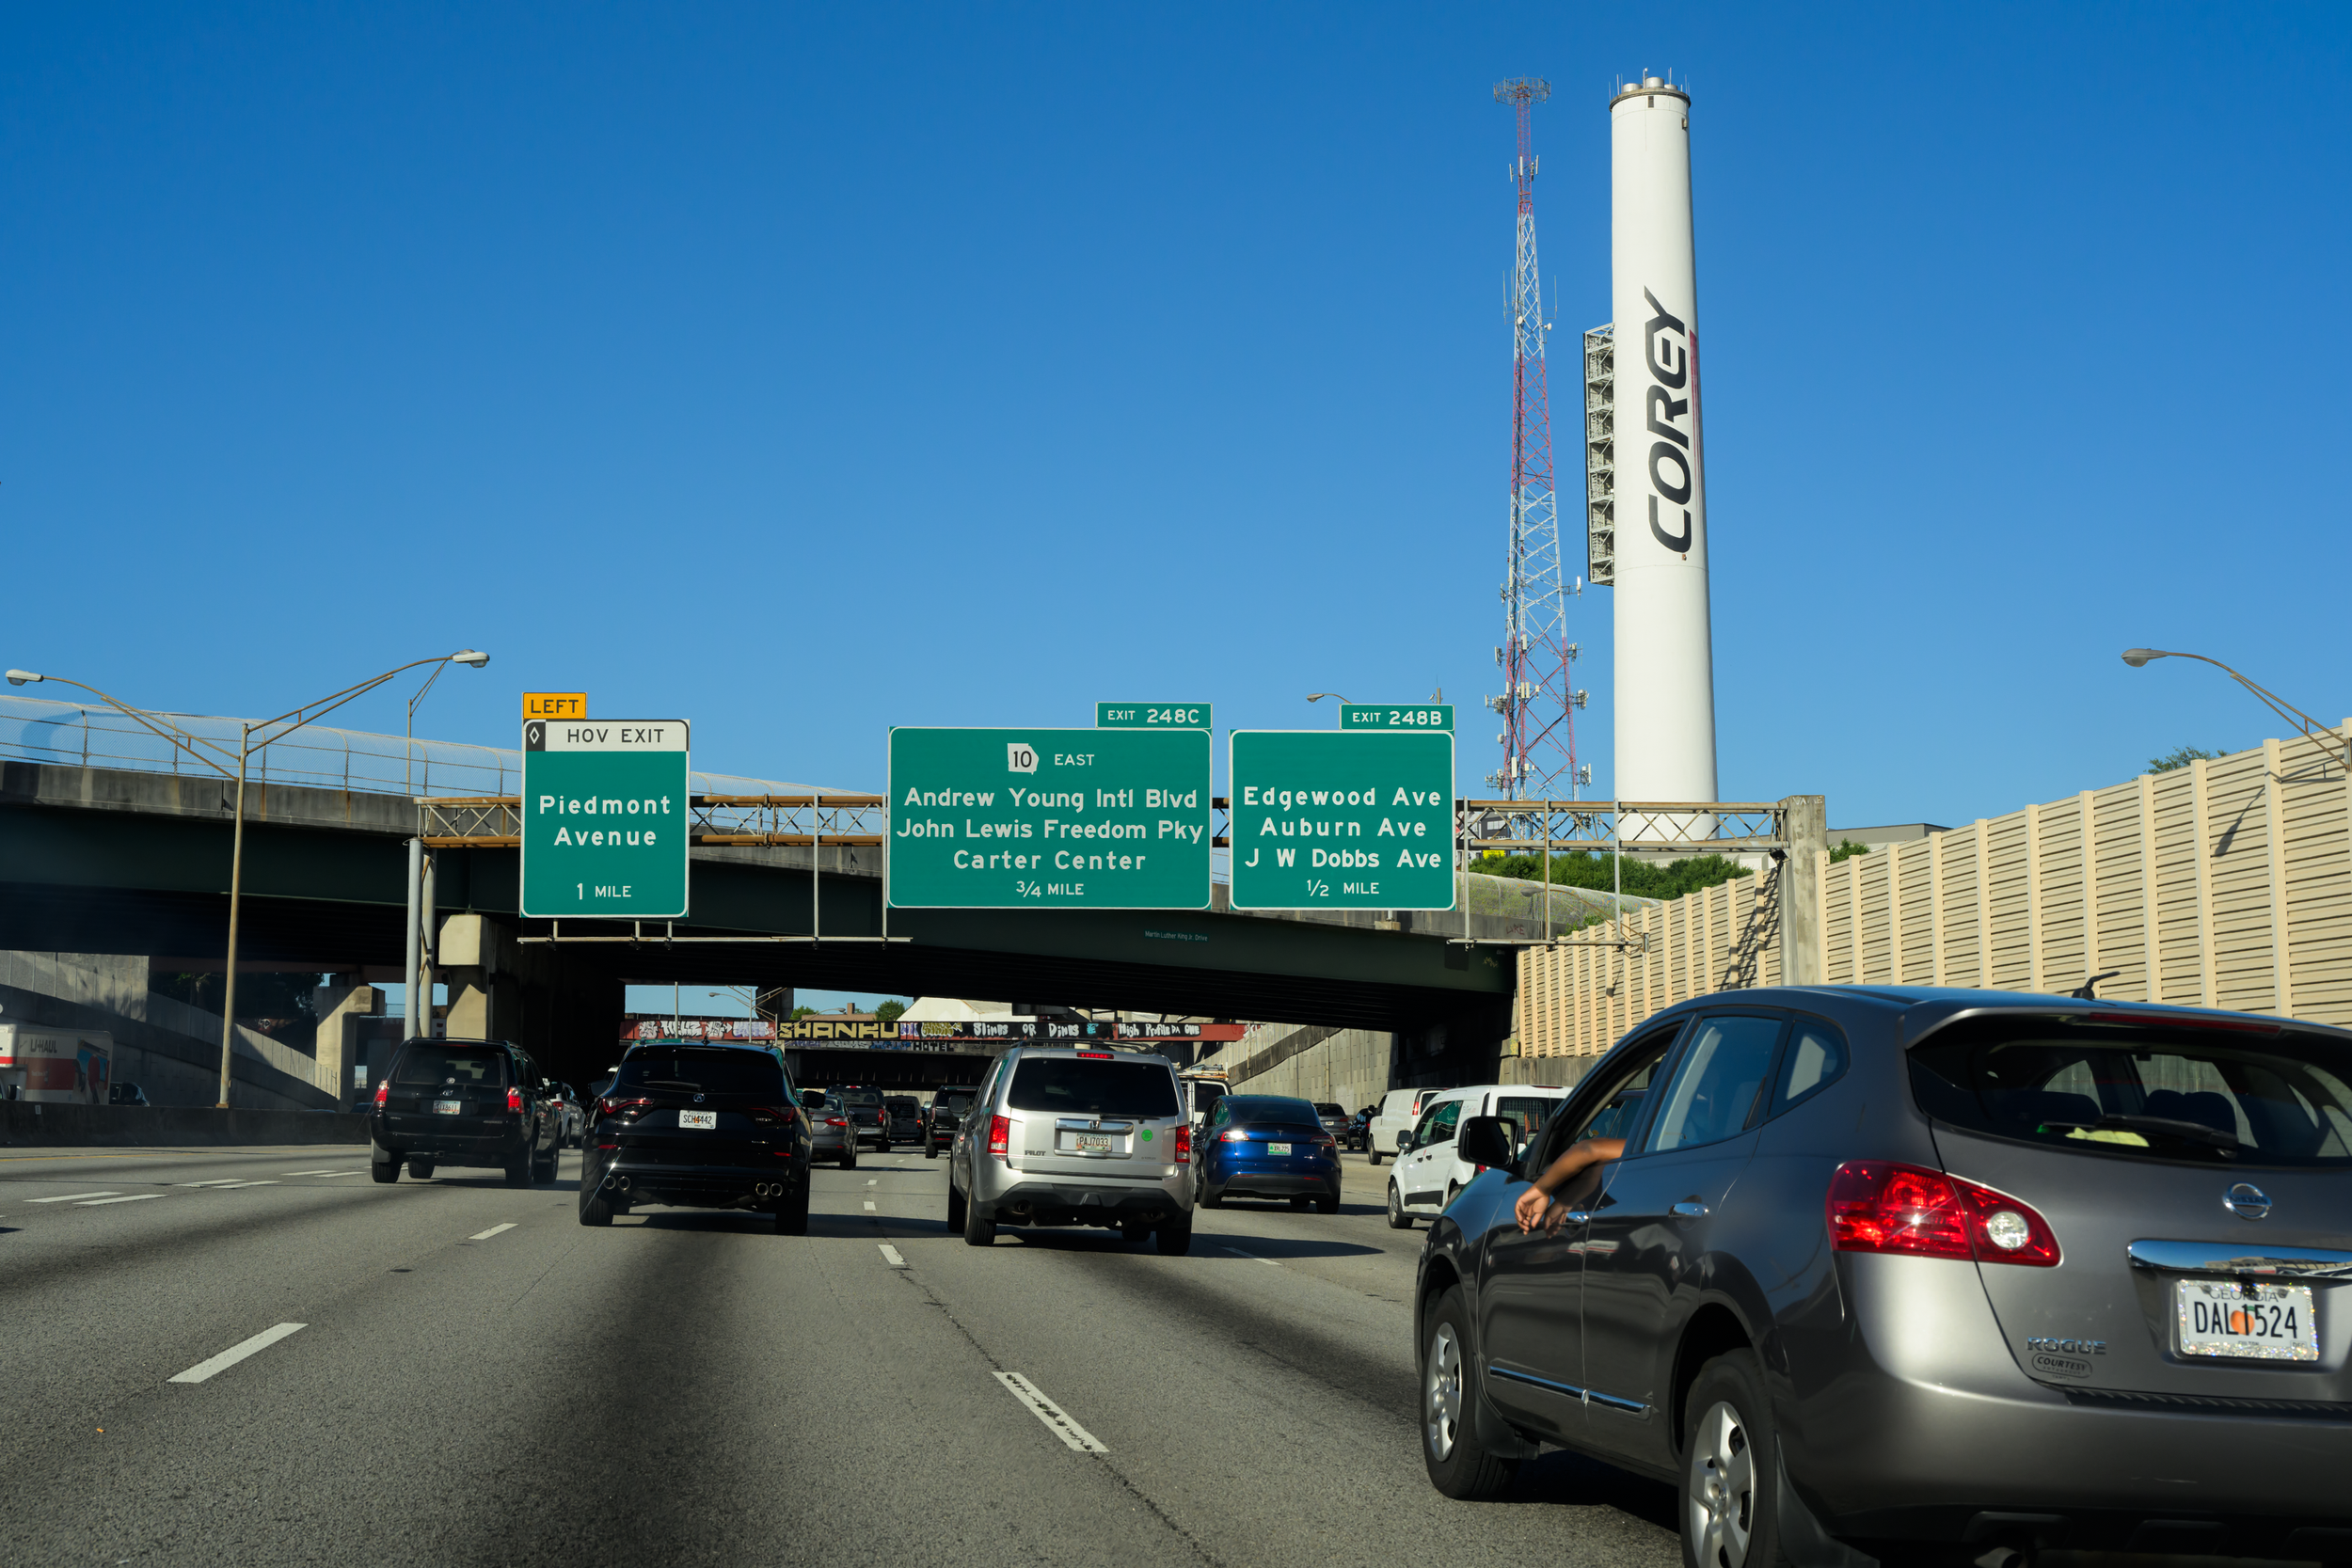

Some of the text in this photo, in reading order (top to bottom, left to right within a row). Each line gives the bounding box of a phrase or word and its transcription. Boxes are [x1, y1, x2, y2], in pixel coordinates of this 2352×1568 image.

[1644, 285, 1692, 553] COREY
[531, 700, 579, 713] LEFT
[1107, 709, 1200, 723] EXIT 248C
[1352, 711, 1442, 725] EXIT 248B
[567, 729, 664, 743] HOV EXIT
[1013, 751, 1095, 768] 10 EAST
[539, 796, 670, 815] Piedmont
[904, 787, 1197, 813] Andrew Young Intl Blvd
[1244, 786, 1441, 812] Edgewood Ave
[897, 818, 1203, 844] John Lewis Freedom Pky
[1260, 817, 1426, 837] Auburn Ave
[554, 827, 657, 846] Avenue
[953, 849, 1146, 870] Carter Center
[1245, 847, 1441, 868] J W Dobbs Ave
[577, 882, 631, 900] 1 MILE
[1016, 880, 1084, 897] 3/4 MILE
[1307, 879, 1379, 896] 1/2 MILE
[2194, 1301, 2297, 1338] DAL1524
[2027, 1337, 2106, 1355] ROGUE
[2037, 1356, 2088, 1371] COURTESY
